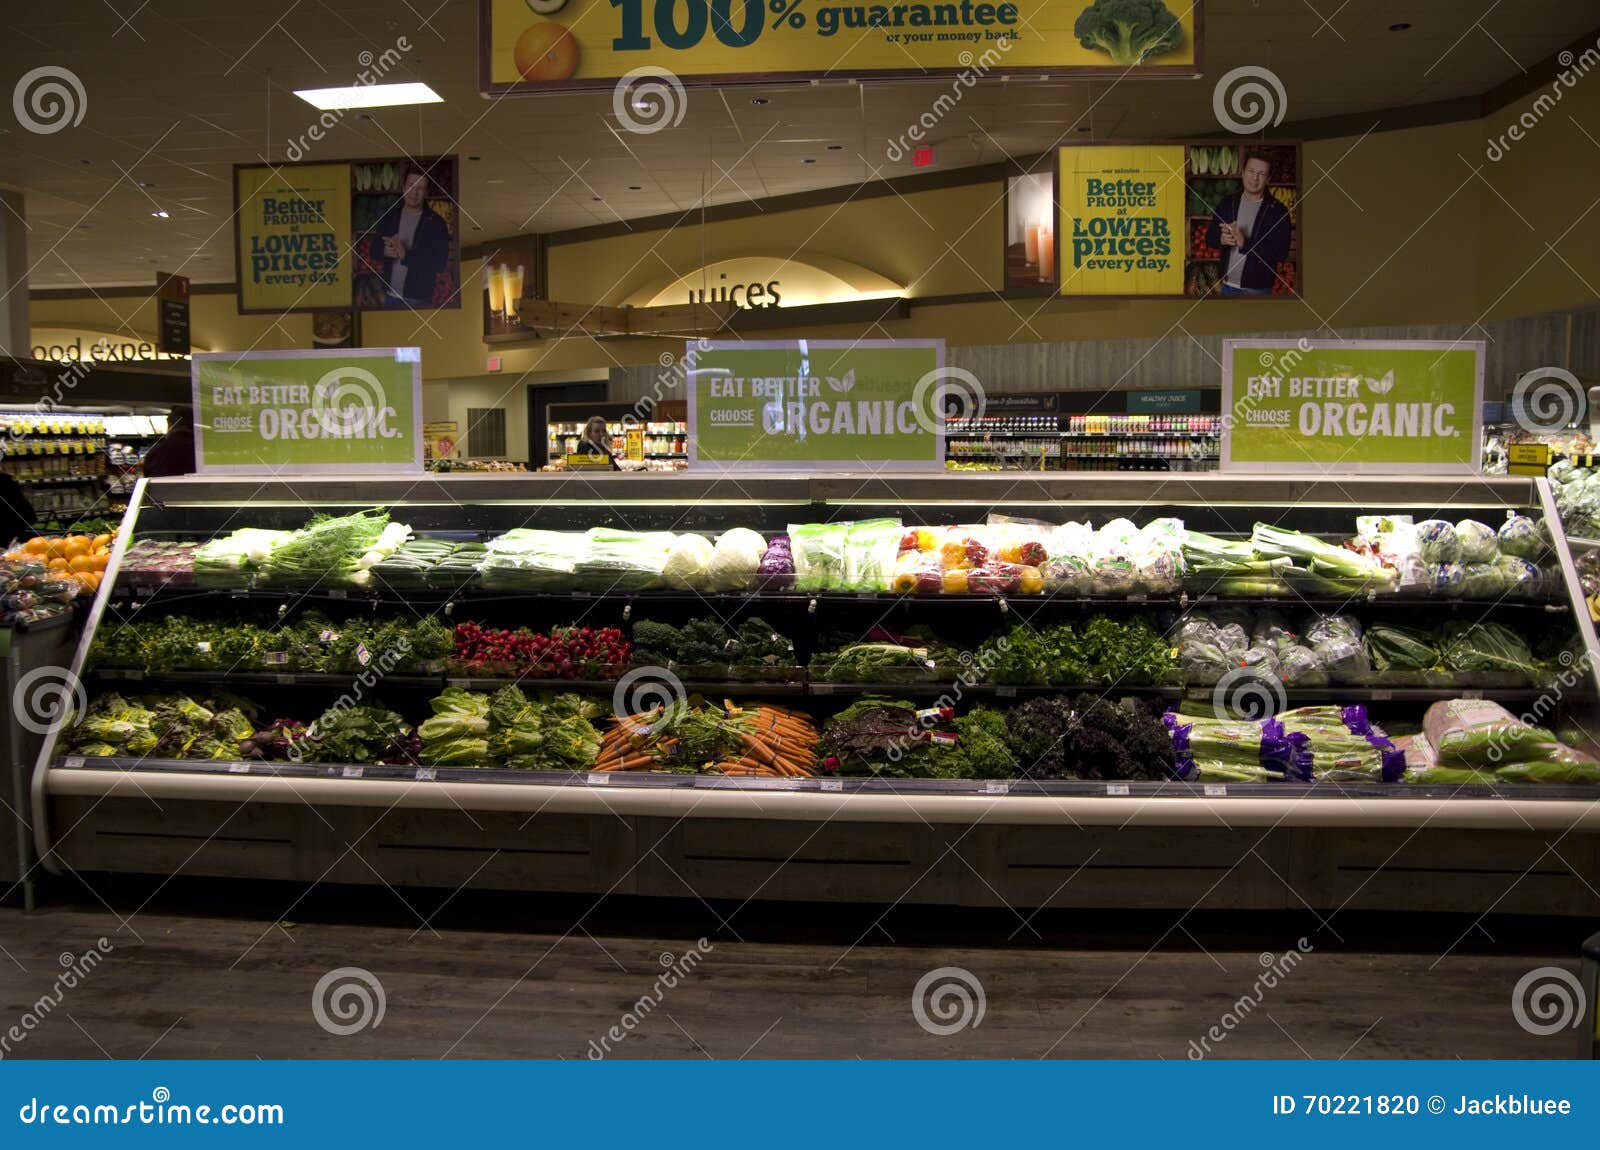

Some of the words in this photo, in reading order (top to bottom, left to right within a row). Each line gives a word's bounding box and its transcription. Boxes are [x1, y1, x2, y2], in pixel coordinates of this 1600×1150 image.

[816, 0, 1018, 36] guarantee
[886, 34, 899, 42] or
[900, 33, 933, 44] your
[937, 31, 981, 43] money
[1086, 178, 1156, 196] Better
[263, 198, 325, 215] Better
[1086, 196, 1156, 207] PRODUCE
[263, 214, 325, 225] PRODUCE
[1072, 217, 1171, 237] LOWER
[251, 233, 338, 254] LOWER
[1072, 236, 1171, 270] prices
[251, 251, 339, 285] prices
[1086, 258, 1135, 273] every
[1136, 256, 1171, 273] day.
[264, 272, 308, 287] every
[309, 270, 339, 286] day.
[31, 337, 81, 362] ood
[212, 386, 244, 406] EAT
[248, 384, 310, 404] BETTER
[710, 376, 744, 398] EAT
[751, 376, 821, 398] BETTER
[1247, 376, 1284, 398] EAT
[1289, 377, 1360, 399] BETTER
[213, 415, 253, 431] CHOOSE
[258, 406, 404, 441] ORGANIC.
[710, 408, 754, 423] CHOOSE
[762, 400, 924, 436] ORGANIC.
[1245, 408, 1291, 423] CHOOSE
[1300, 402, 1461, 438] ORGANIC.
